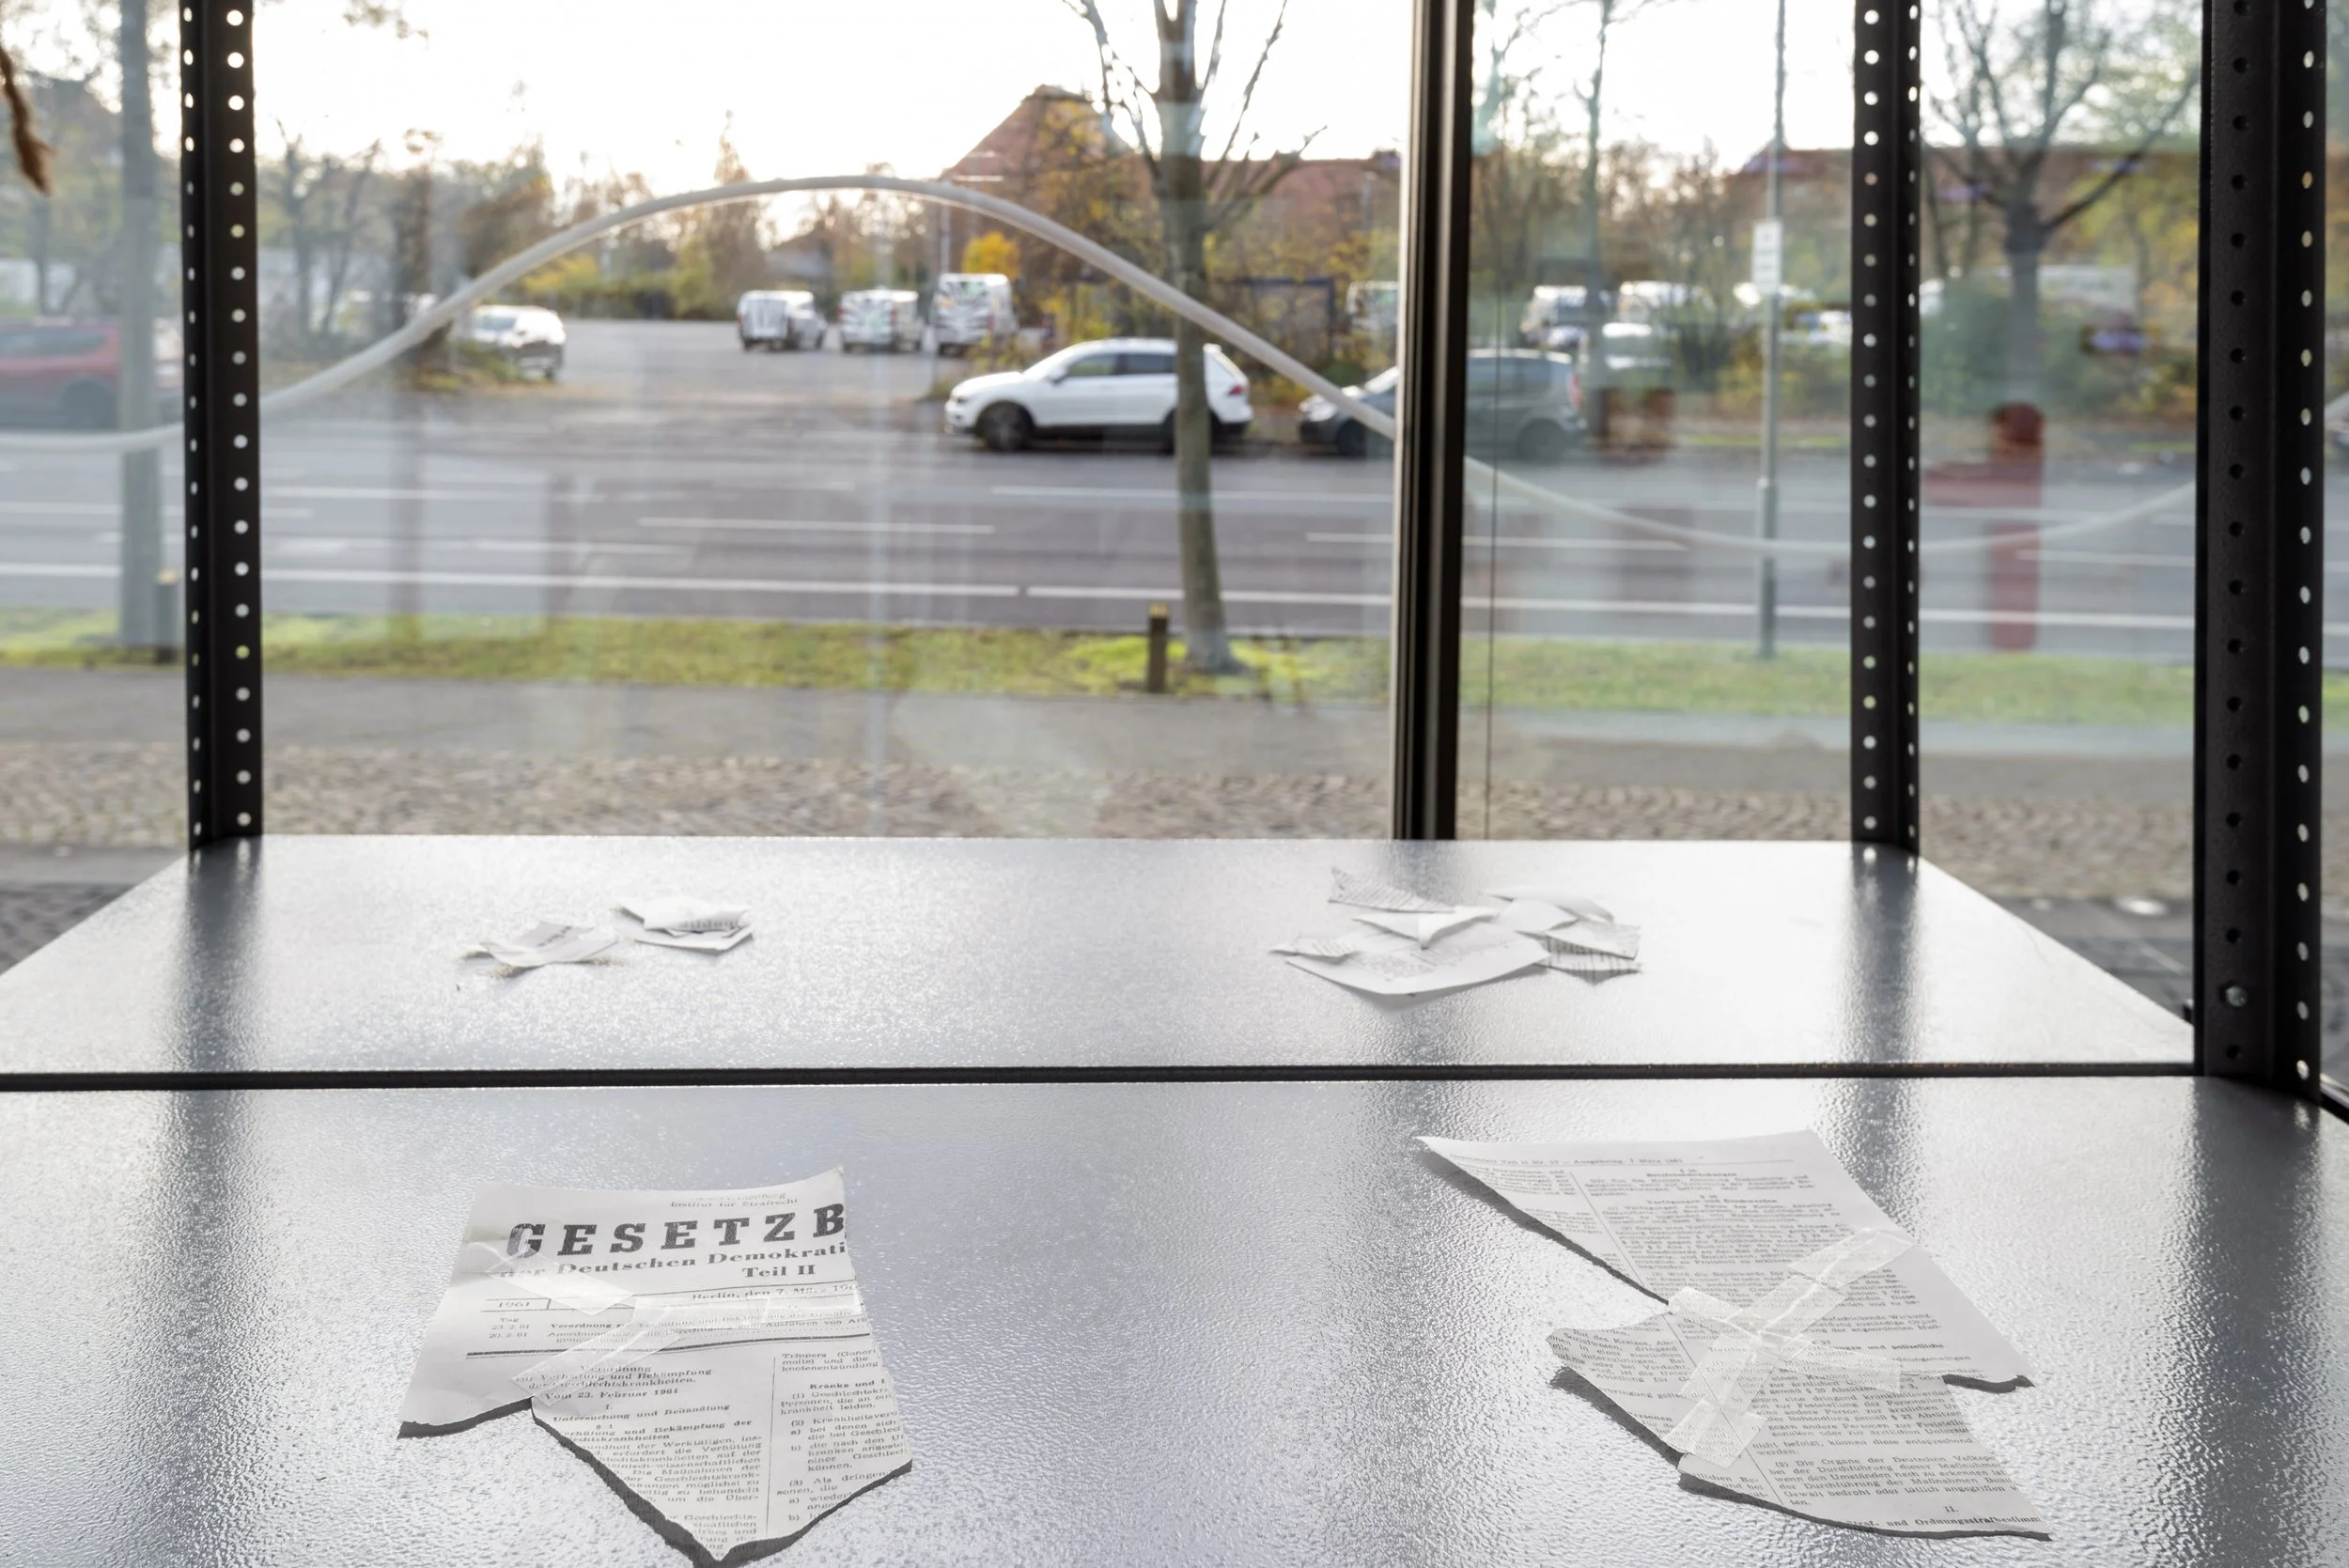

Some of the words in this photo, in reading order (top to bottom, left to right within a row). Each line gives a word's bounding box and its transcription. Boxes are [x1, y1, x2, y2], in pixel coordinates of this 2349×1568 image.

[506, 1203, 845, 1259] GESETZB
[557, 1257, 696, 1275] Deutschen
[708, 1242, 845, 1265] Demokrati
[742, 1266, 786, 1278] Teil
[798, 1265, 816, 1275] II
[781, 1399, 832, 1407] Personen,
[1812, 1394, 1857, 1403] dringend
[781, 1405, 833, 1415] krankheit
[808, 1447, 854, 1456] kranken
[1821, 1457, 1860, 1466] Organe
[1891, 1455, 1947, 1464] Deutschen
[1817, 1464, 1893, 1473] Durchführung
[1808, 1473, 1827, 1482] den
[1803, 1479, 1881, 1490] Durchführung
[1828, 1487, 1871, 1497] bedroht
[1887, 1518, 1908, 1527] und
